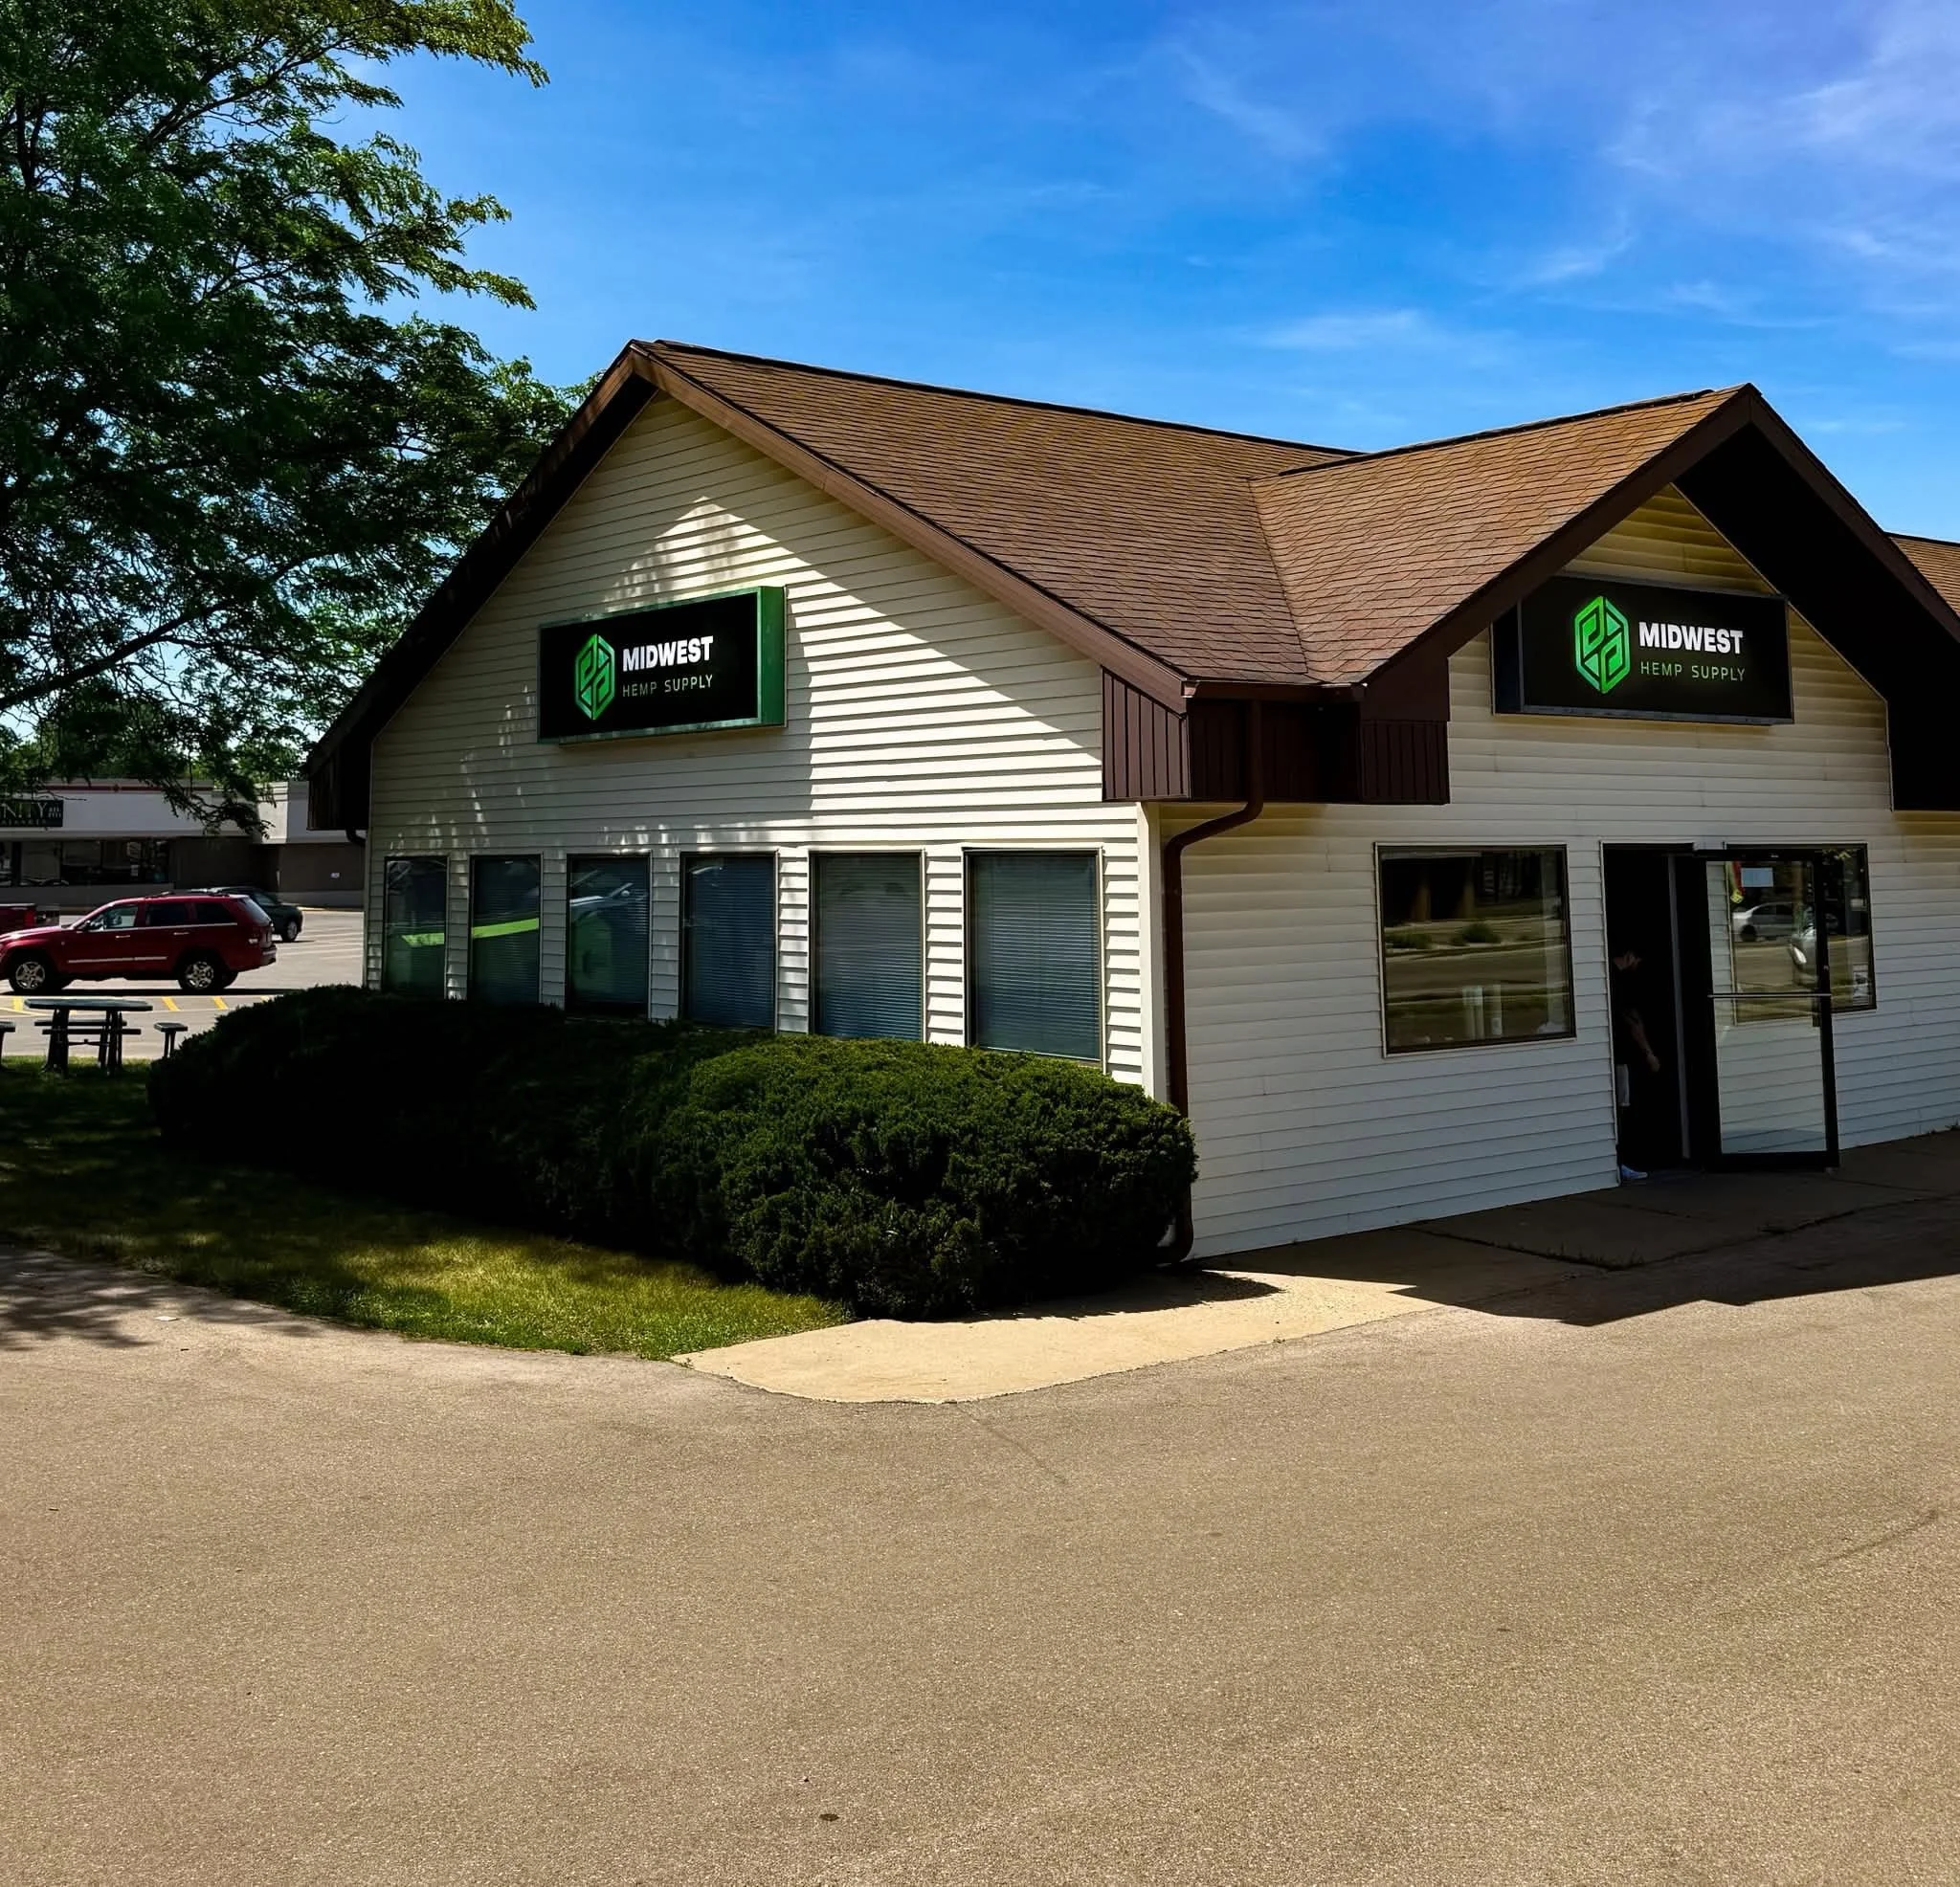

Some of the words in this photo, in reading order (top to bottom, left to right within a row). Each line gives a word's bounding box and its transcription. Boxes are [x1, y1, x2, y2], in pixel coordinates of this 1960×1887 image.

[1638, 622, 1744, 655] MIDWEST
[623, 636, 714, 672] MIDWEST
[1640, 660, 1682, 677] HEMP
[1691, 665, 1746, 681] SUPPLY
[623, 681, 657, 698] HEMP
[664, 675, 713, 693] SUPPLY
